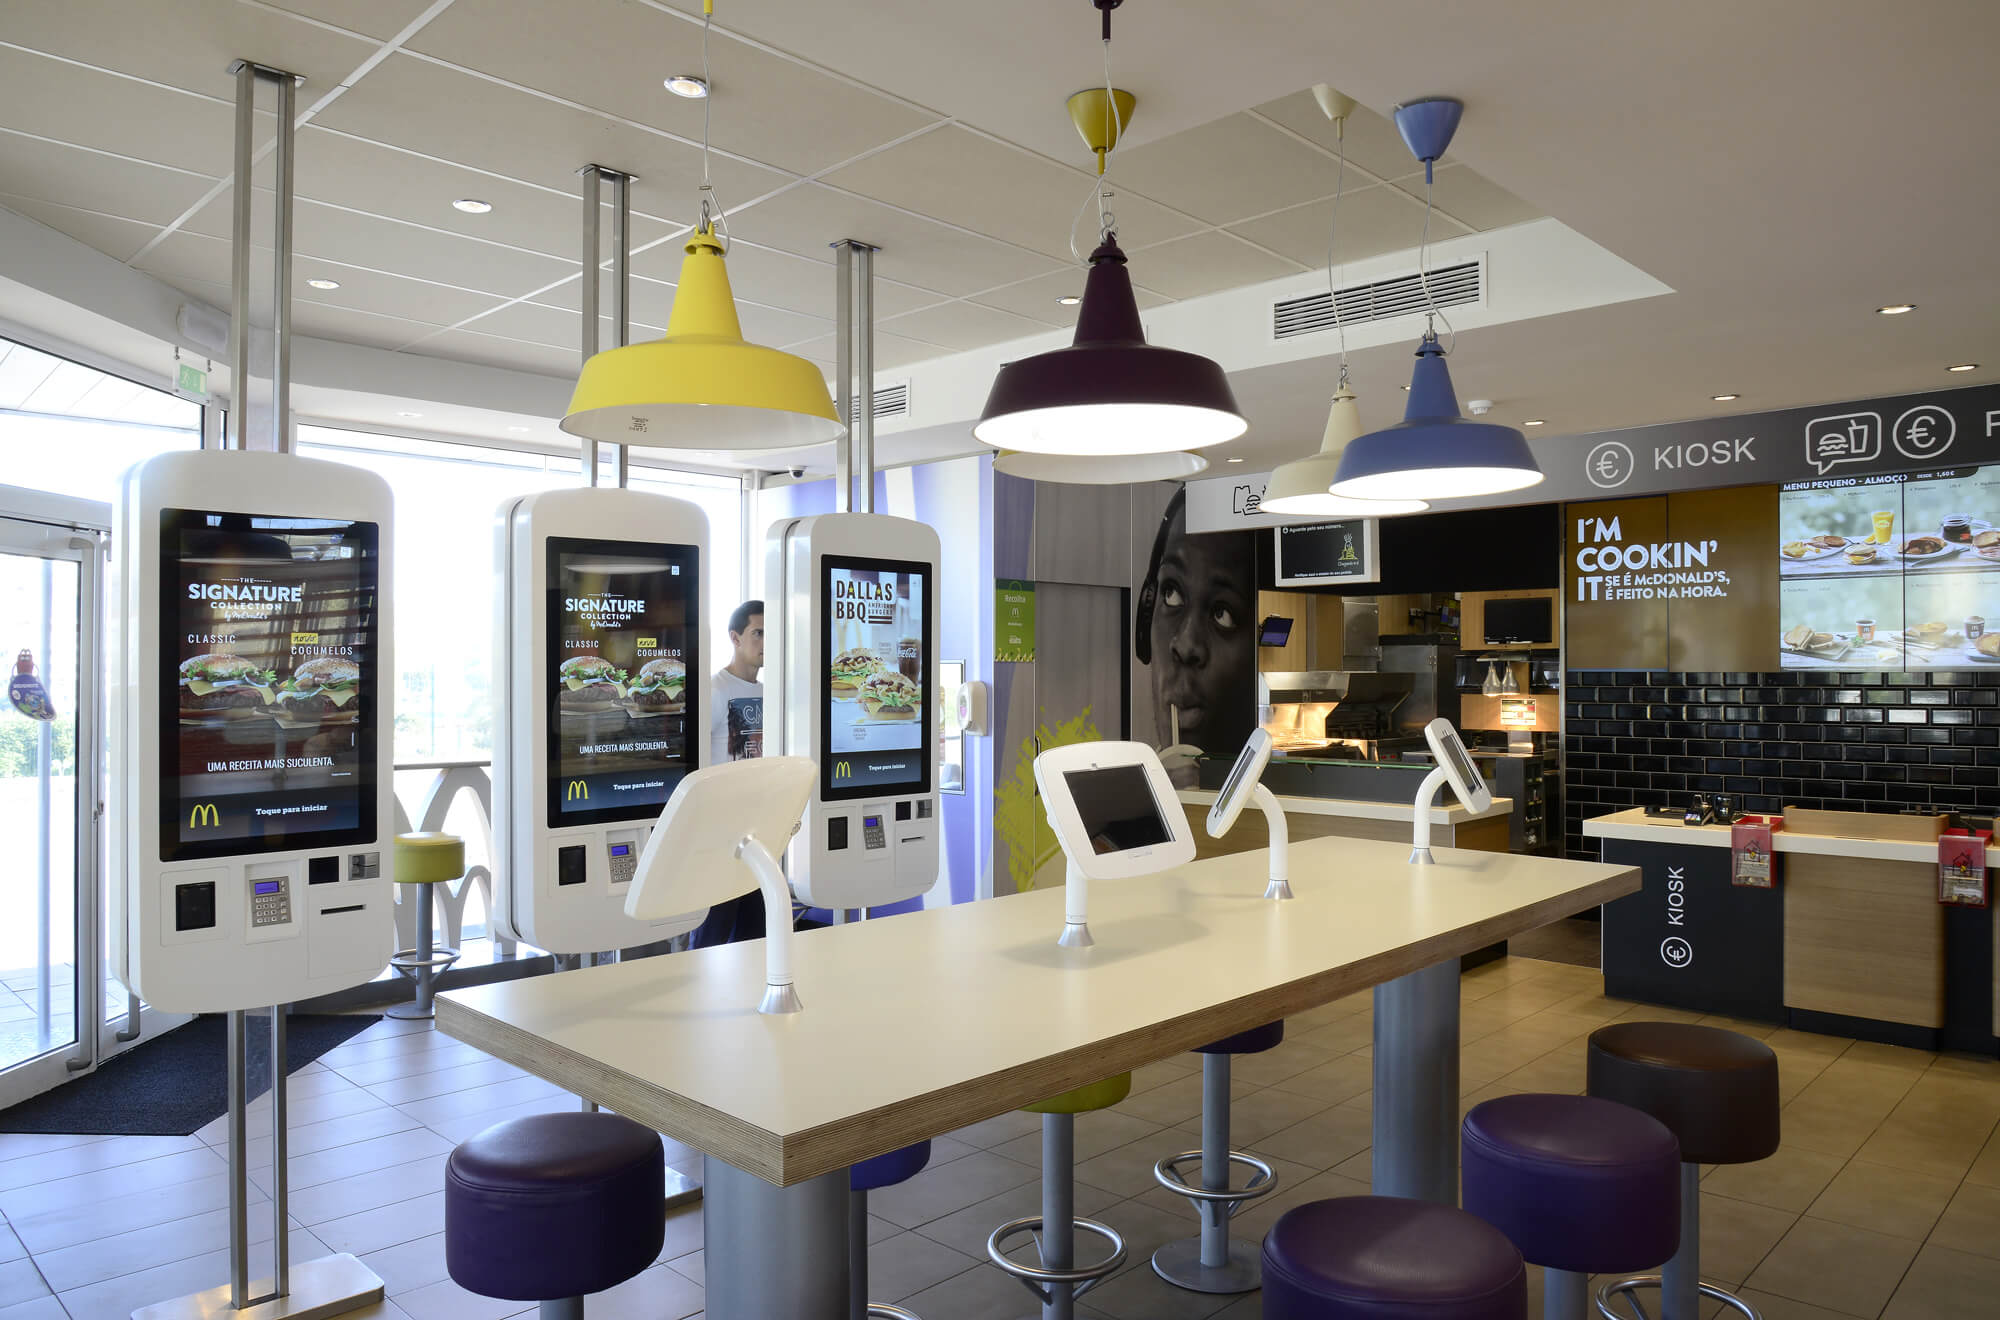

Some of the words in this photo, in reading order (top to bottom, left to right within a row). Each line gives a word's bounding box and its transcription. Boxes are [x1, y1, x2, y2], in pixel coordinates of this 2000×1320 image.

[1654, 436, 1757, 471] KIOSK
[1783, 480, 1810, 491] MENU
[1811, 477, 1857, 490] PEQUENO
[1864, 473, 1908, 486] ALMOÇO
[1576, 539, 1718, 572] COOKIN'
[1604, 575, 1621, 587] SE
[1623, 571, 1632, 586] É
[1634, 570, 1730, 586] McDONALD'S,
[188, 583, 302, 602] SIGNATURE
[836, 580, 893, 601] DALLAS
[1577, 575, 1603, 602] IT
[1605, 586, 1614, 600] É
[1616, 587, 1654, 600] FEITO
[1657, 586, 1679, 599] NA
[1680, 585, 1727, 598] HORA.
[210, 601, 282, 610] COLLECTION
[565, 598, 645, 613] SIGNATURE
[836, 600, 866, 624] BBQ
[187, 633, 236, 644] CLASSIC
[565, 640, 599, 648] CLASSIC
[290, 645, 353, 656] COGUMELOS
[637, 648, 681, 657] COGUMELOS
[579, 745, 594, 754] UMA
[594, 743, 618, 753] RECEITA
[619, 742, 634, 752] MAIS
[634, 741, 669, 751] SUCULENTA.
[207, 761, 227, 772] UMA
[229, 759, 263, 771] RECEITA
[264, 757, 285, 770] MAIS
[286, 756, 335, 768] SUCULENTA.
[255, 806, 281, 816] Toque
[282, 805, 301, 815] para
[301, 803, 328, 813] iniciar
[1668, 866, 1684, 926] KIOSK
